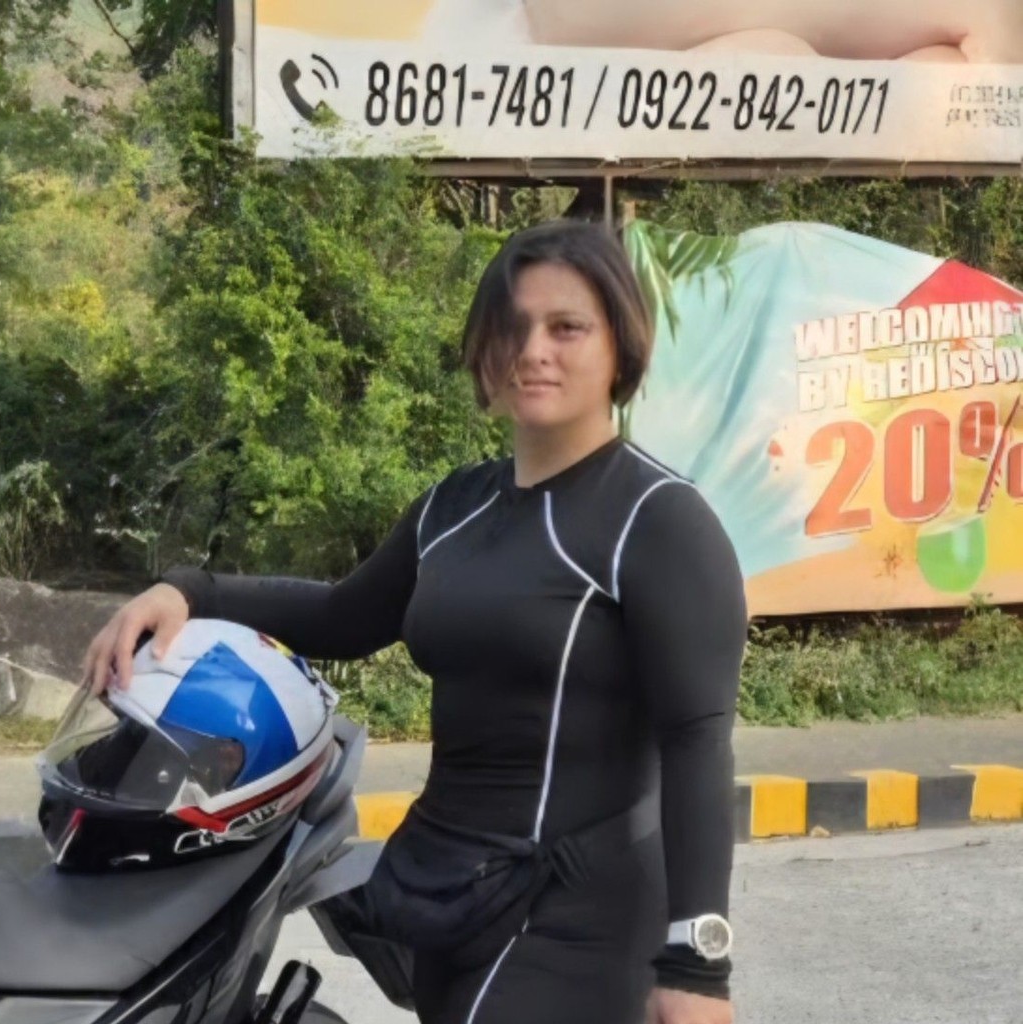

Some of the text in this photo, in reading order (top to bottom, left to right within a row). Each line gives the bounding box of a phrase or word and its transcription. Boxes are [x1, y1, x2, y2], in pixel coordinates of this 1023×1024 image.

[365, 61, 575, 128] 8681-7481
[617, 67, 890, 135] 0922-842-0171
[798, 337, 1023, 412] BY REDISCO
